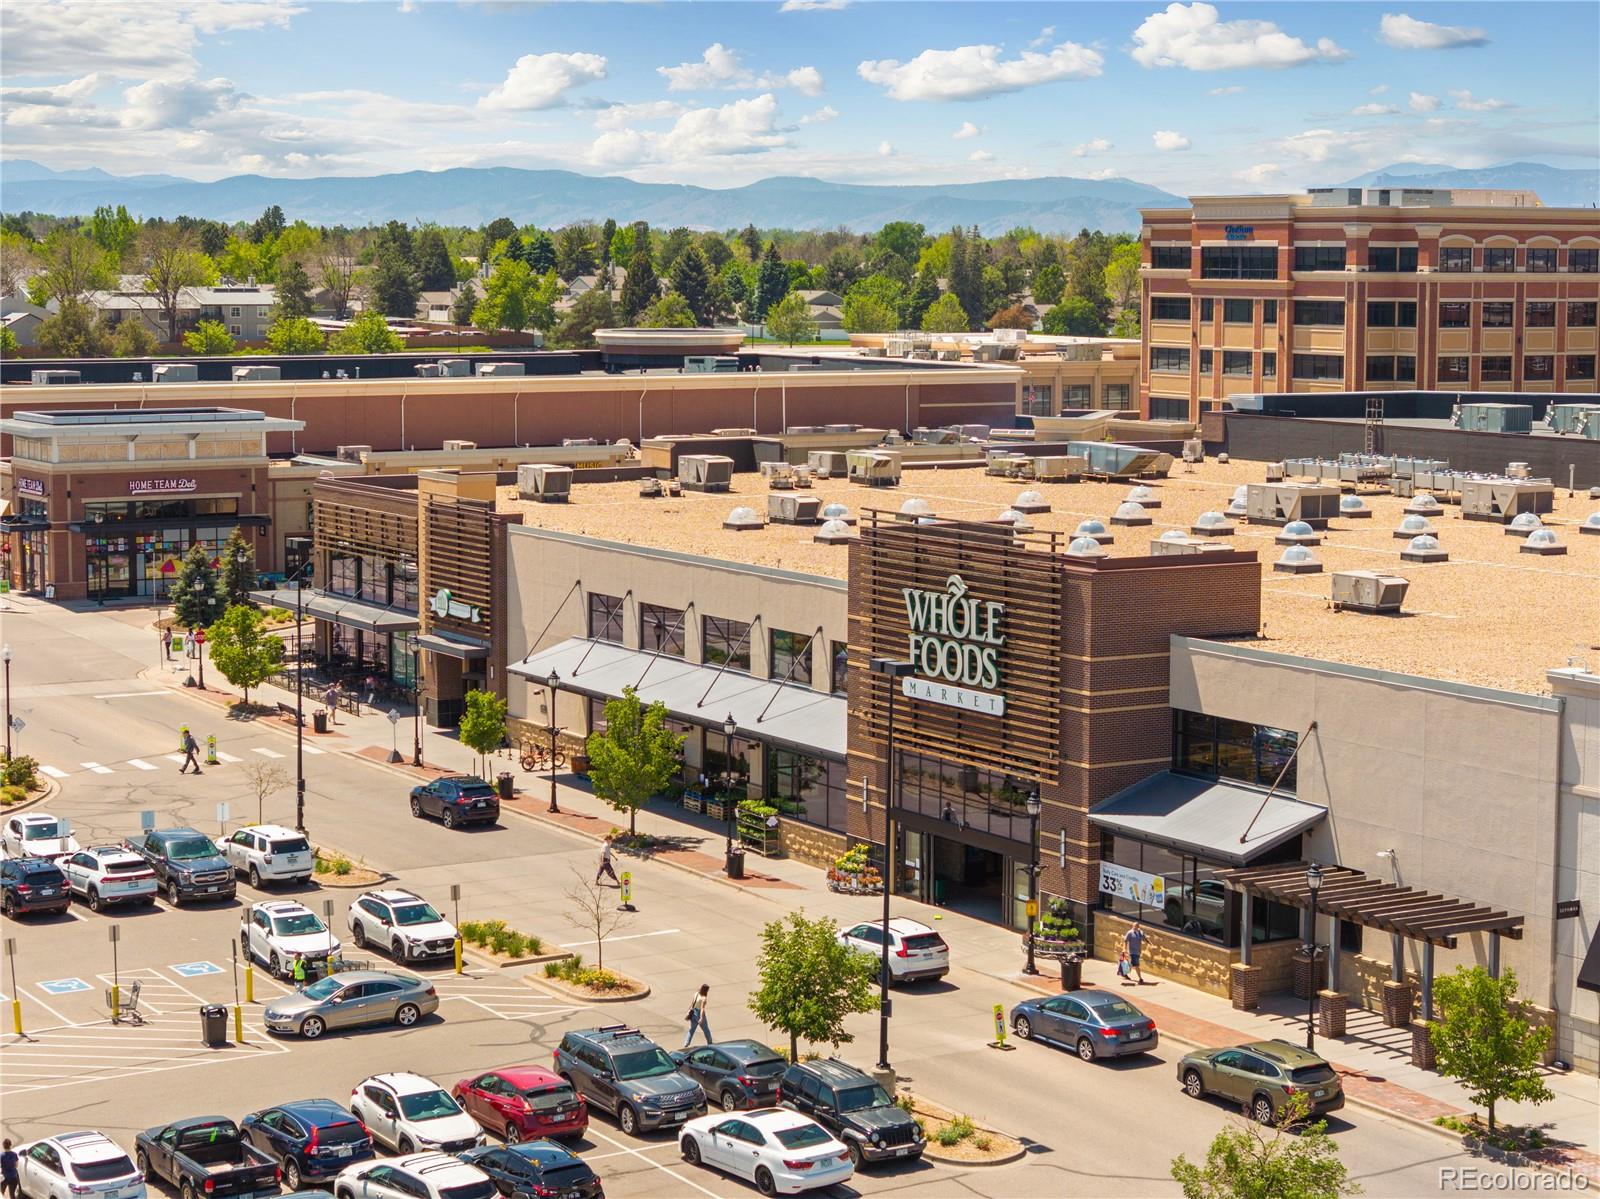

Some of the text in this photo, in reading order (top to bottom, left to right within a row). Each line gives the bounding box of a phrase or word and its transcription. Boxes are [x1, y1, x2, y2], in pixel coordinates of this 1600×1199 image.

[129, 479, 197, 490] HOME TEAM Deli
[902, 575, 1007, 645] WHOLE
[908, 634, 1000, 689] FOODS
[909, 682, 996, 711] MARKET
